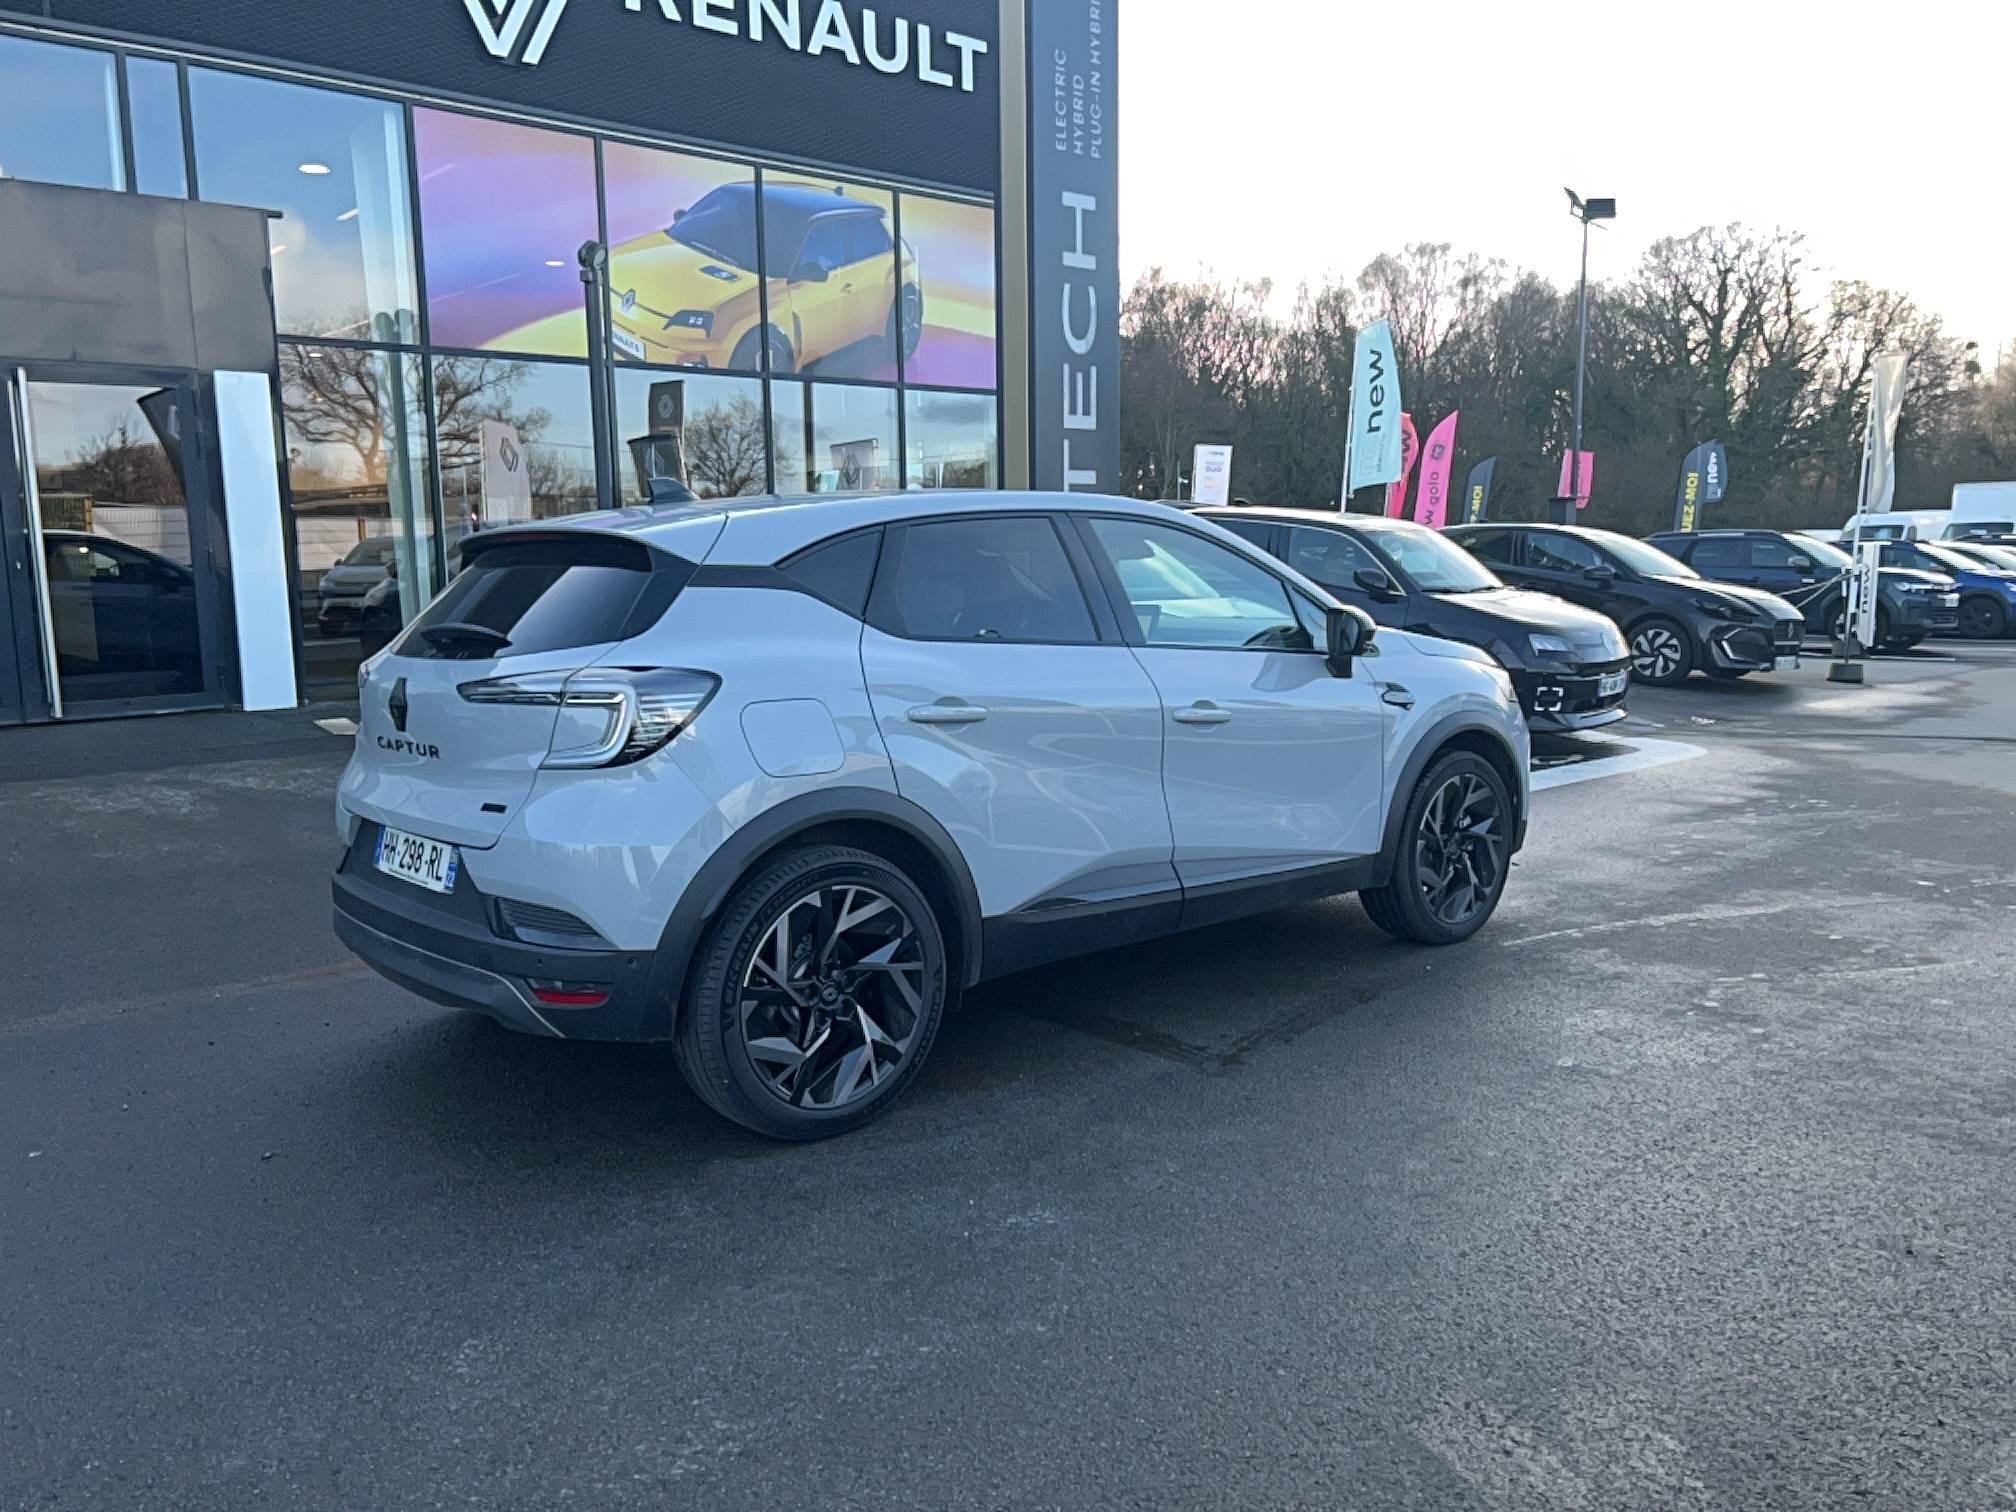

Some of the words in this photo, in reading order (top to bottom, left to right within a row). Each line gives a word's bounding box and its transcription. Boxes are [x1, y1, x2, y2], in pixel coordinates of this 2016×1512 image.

[625, 0, 988, 92] ENAULT
[1054, 48, 1067, 152] ELECTRIC
[1072, 74, 1085, 156] HYBRID
[1090, 71, 1103, 159] PLUG-IN
[1061, 190, 1097, 493] TECH
[1365, 348, 1384, 435] new
[376, 736, 441, 760] CAPTUR
